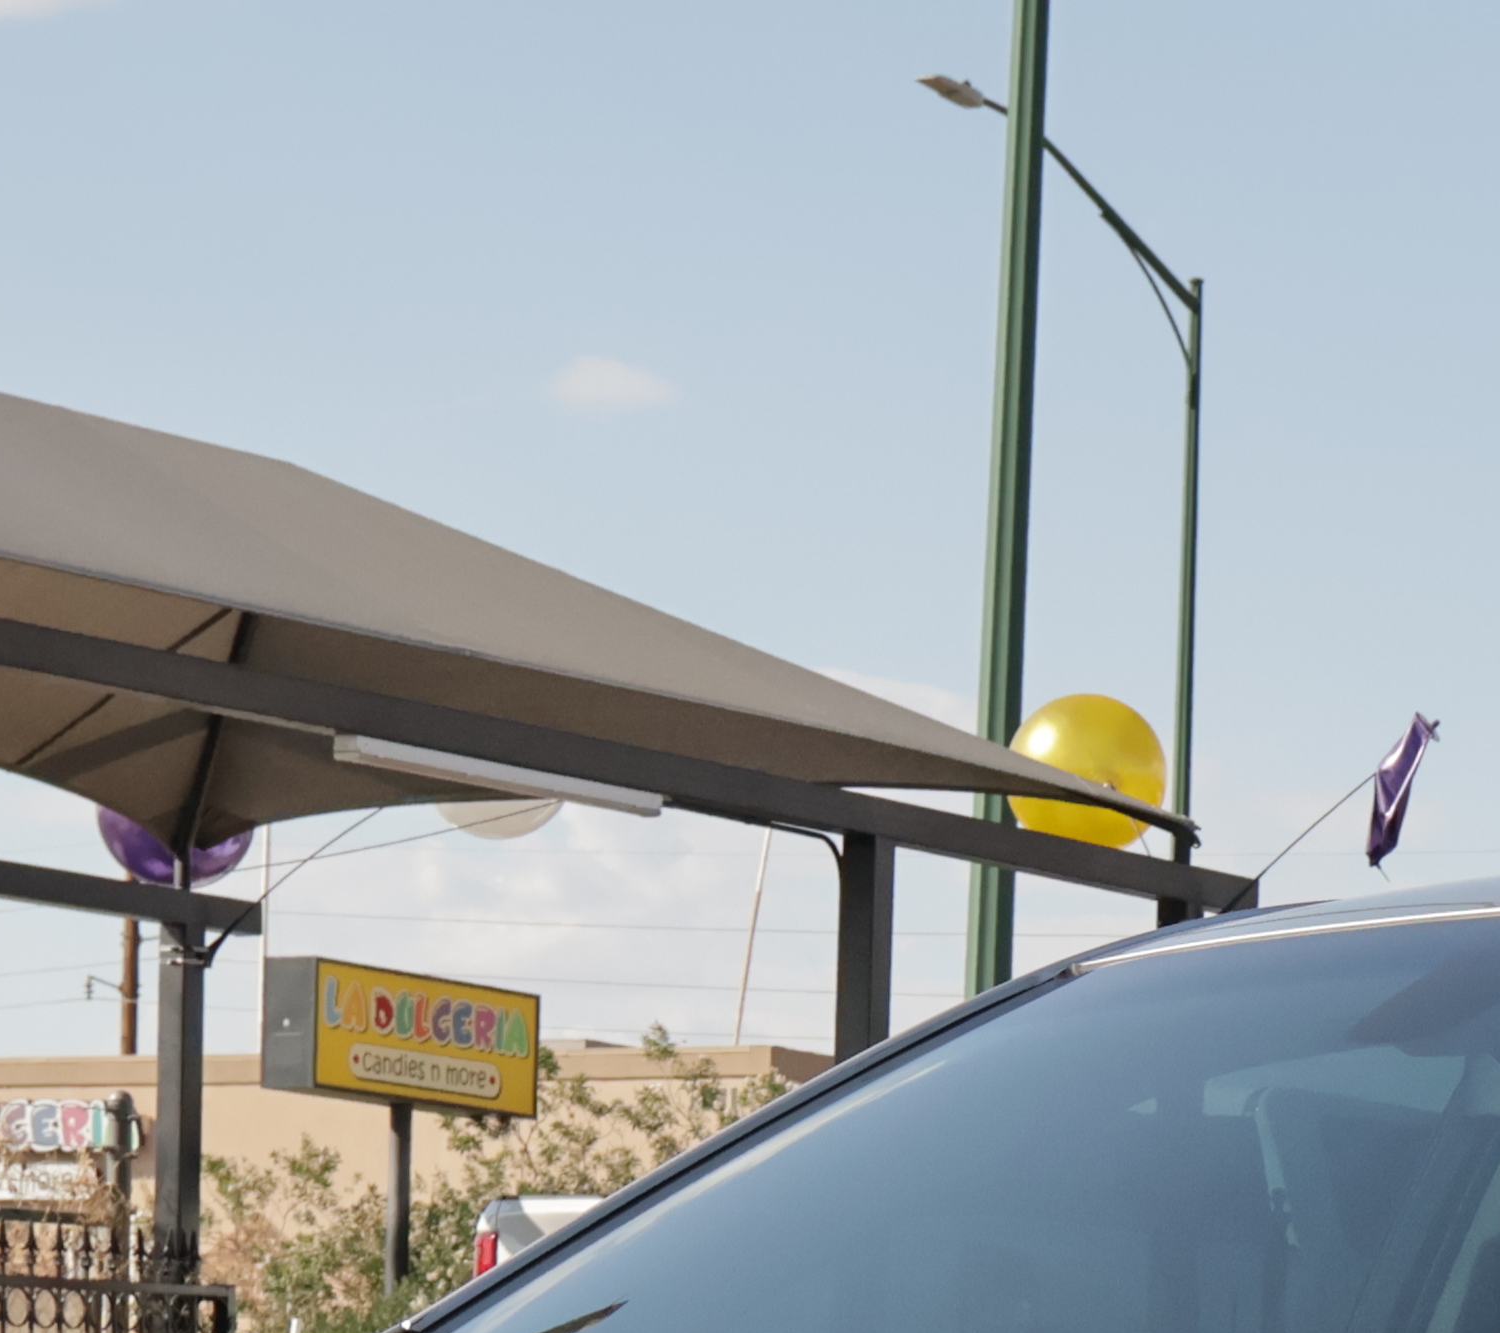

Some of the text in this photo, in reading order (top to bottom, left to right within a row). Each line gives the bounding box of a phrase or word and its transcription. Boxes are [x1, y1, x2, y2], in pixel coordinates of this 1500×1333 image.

[323, 974, 529, 1059] LA DULCERIA
[361, 1051, 488, 1089] Candies n more
